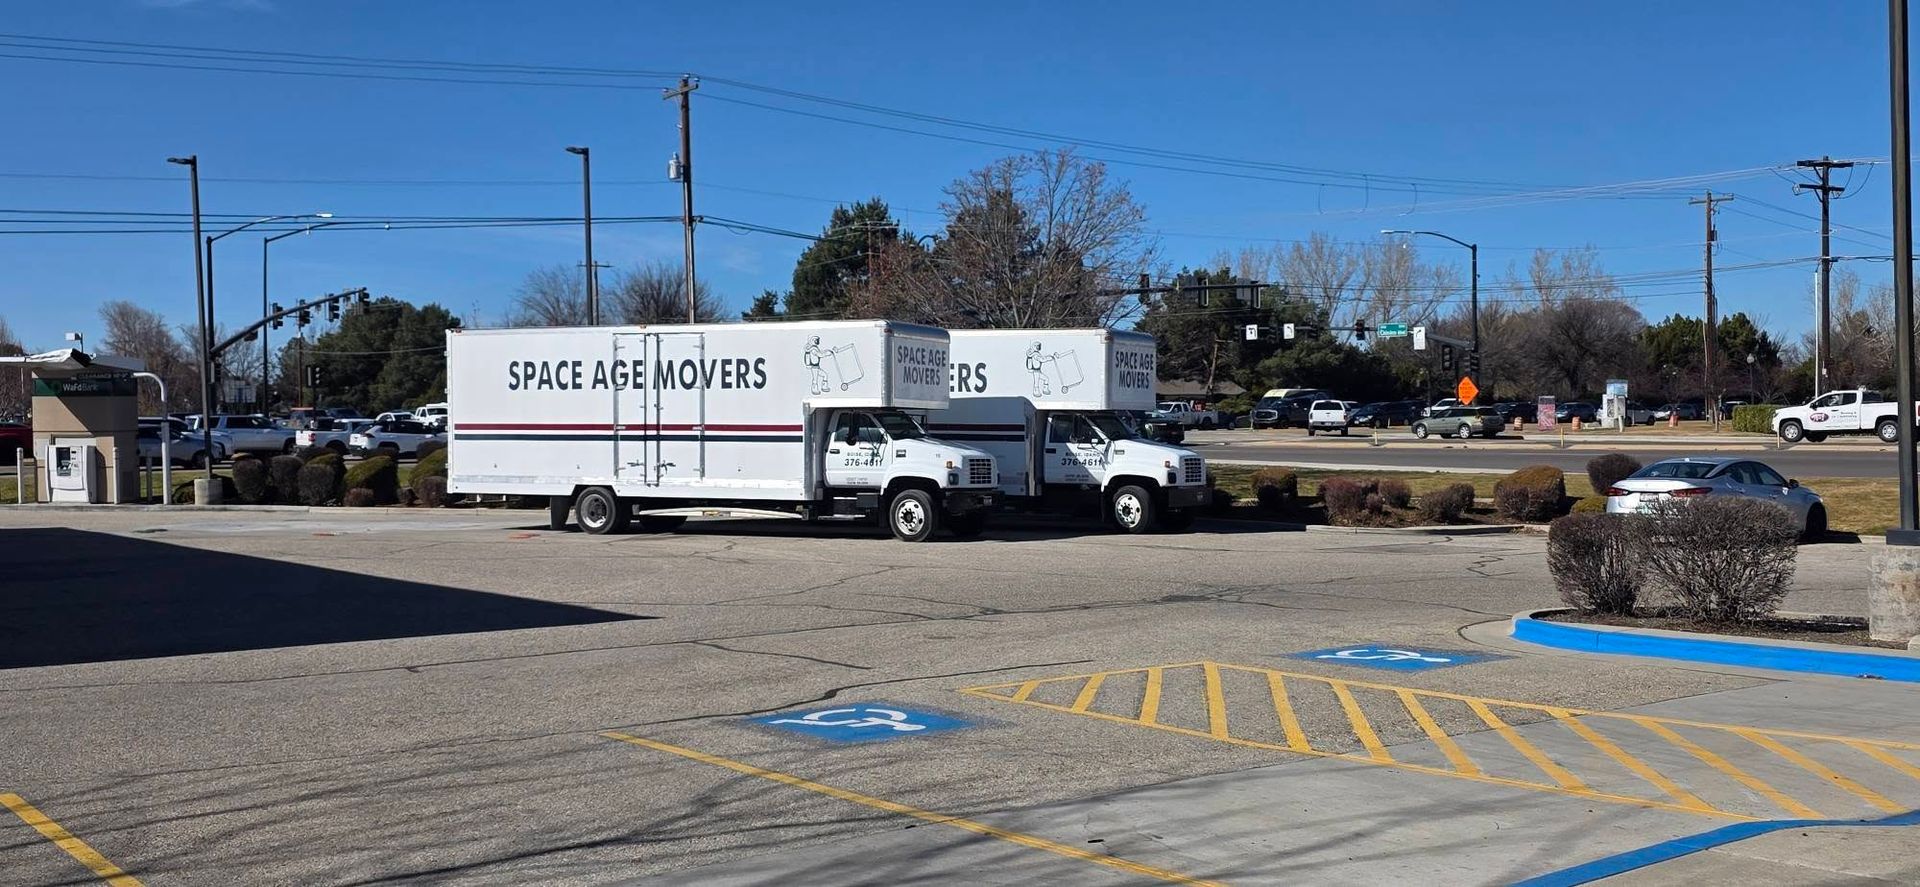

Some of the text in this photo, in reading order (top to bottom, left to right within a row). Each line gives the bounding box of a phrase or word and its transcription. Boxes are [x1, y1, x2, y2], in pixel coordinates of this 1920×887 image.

[897, 345, 947, 366] SPACE AGE
[1115, 351, 1154, 370] SPACE AGE
[508, 357, 767, 391] SPACE AGE MOVERS
[903, 365, 941, 386] MOVERS
[1118, 371, 1150, 389] MOVERS
